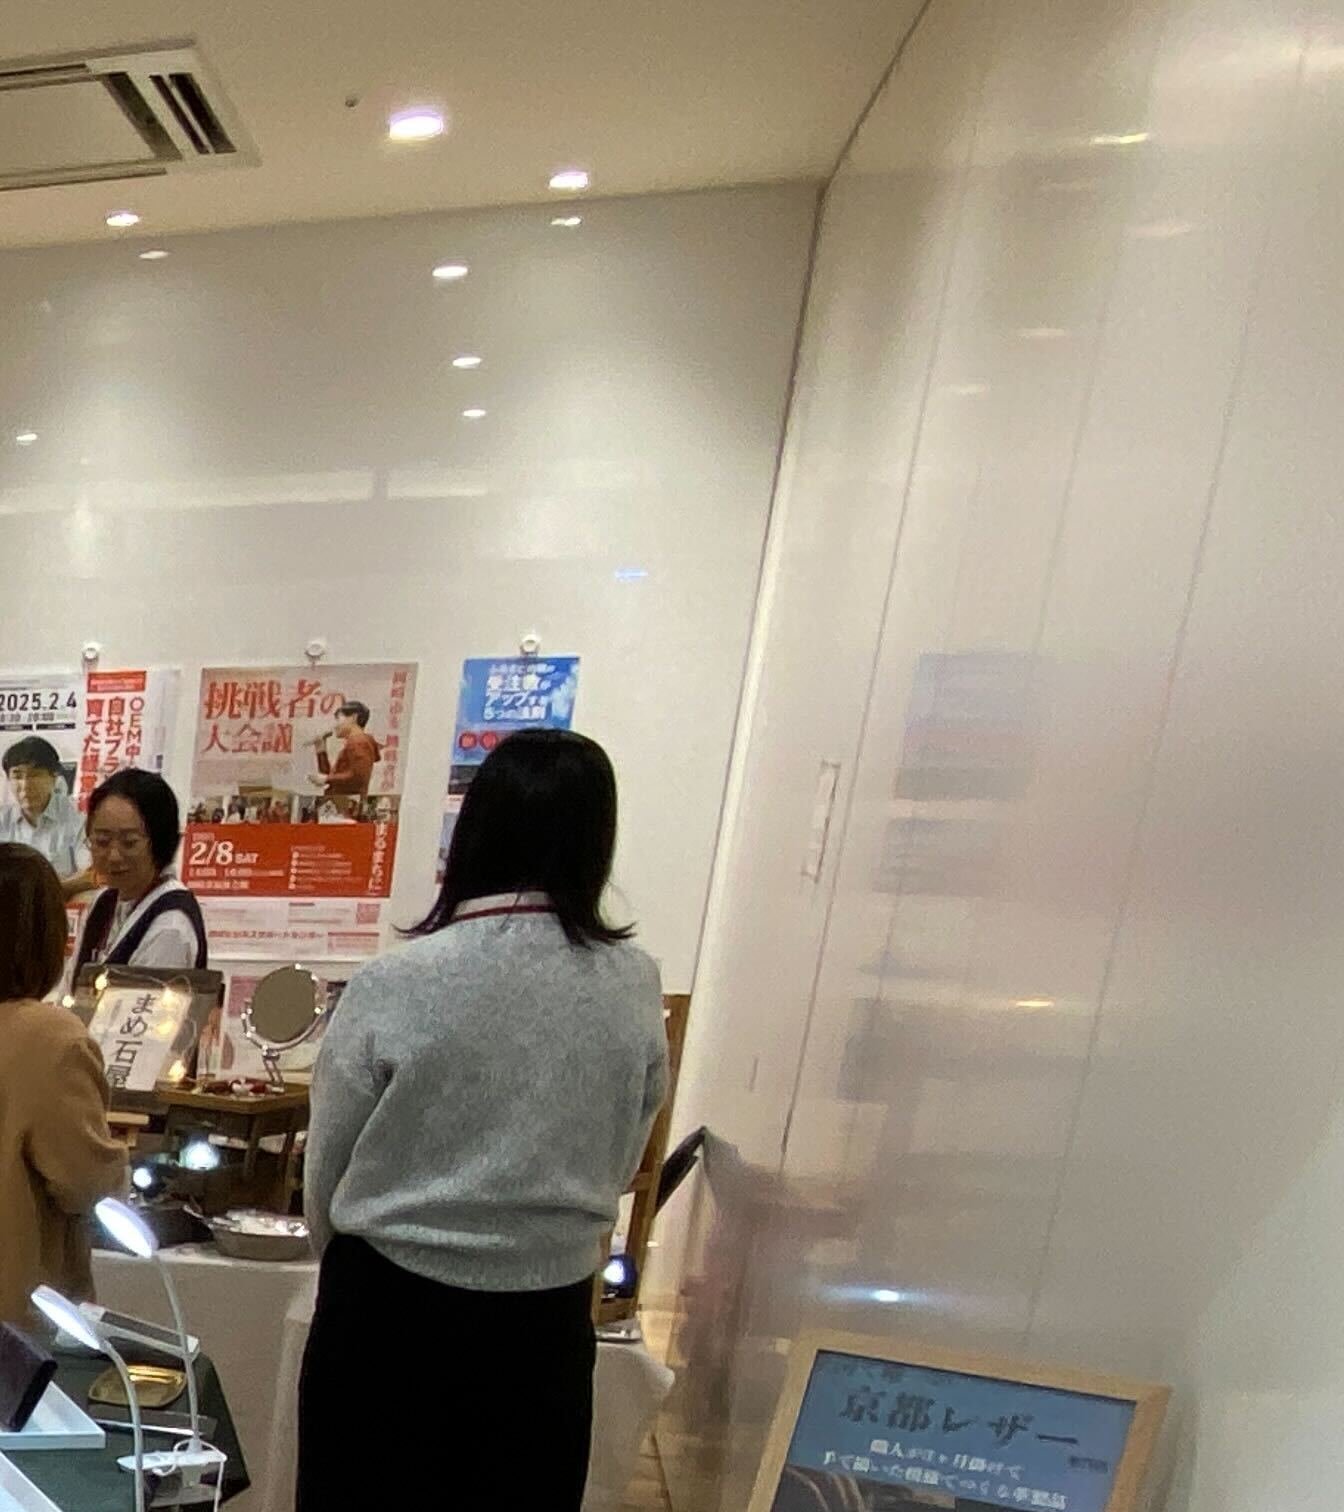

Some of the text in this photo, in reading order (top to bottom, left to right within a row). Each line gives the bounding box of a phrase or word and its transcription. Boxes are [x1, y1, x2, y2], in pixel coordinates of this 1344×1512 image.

[205, 679, 346, 720] 挑戦者の
[188, 840, 234, 866] 2/8
[235, 853, 259, 864] SAT
[105, 994, 157, 1089] まめ石屋
[839, 1385, 1079, 1449] 京都レザー
